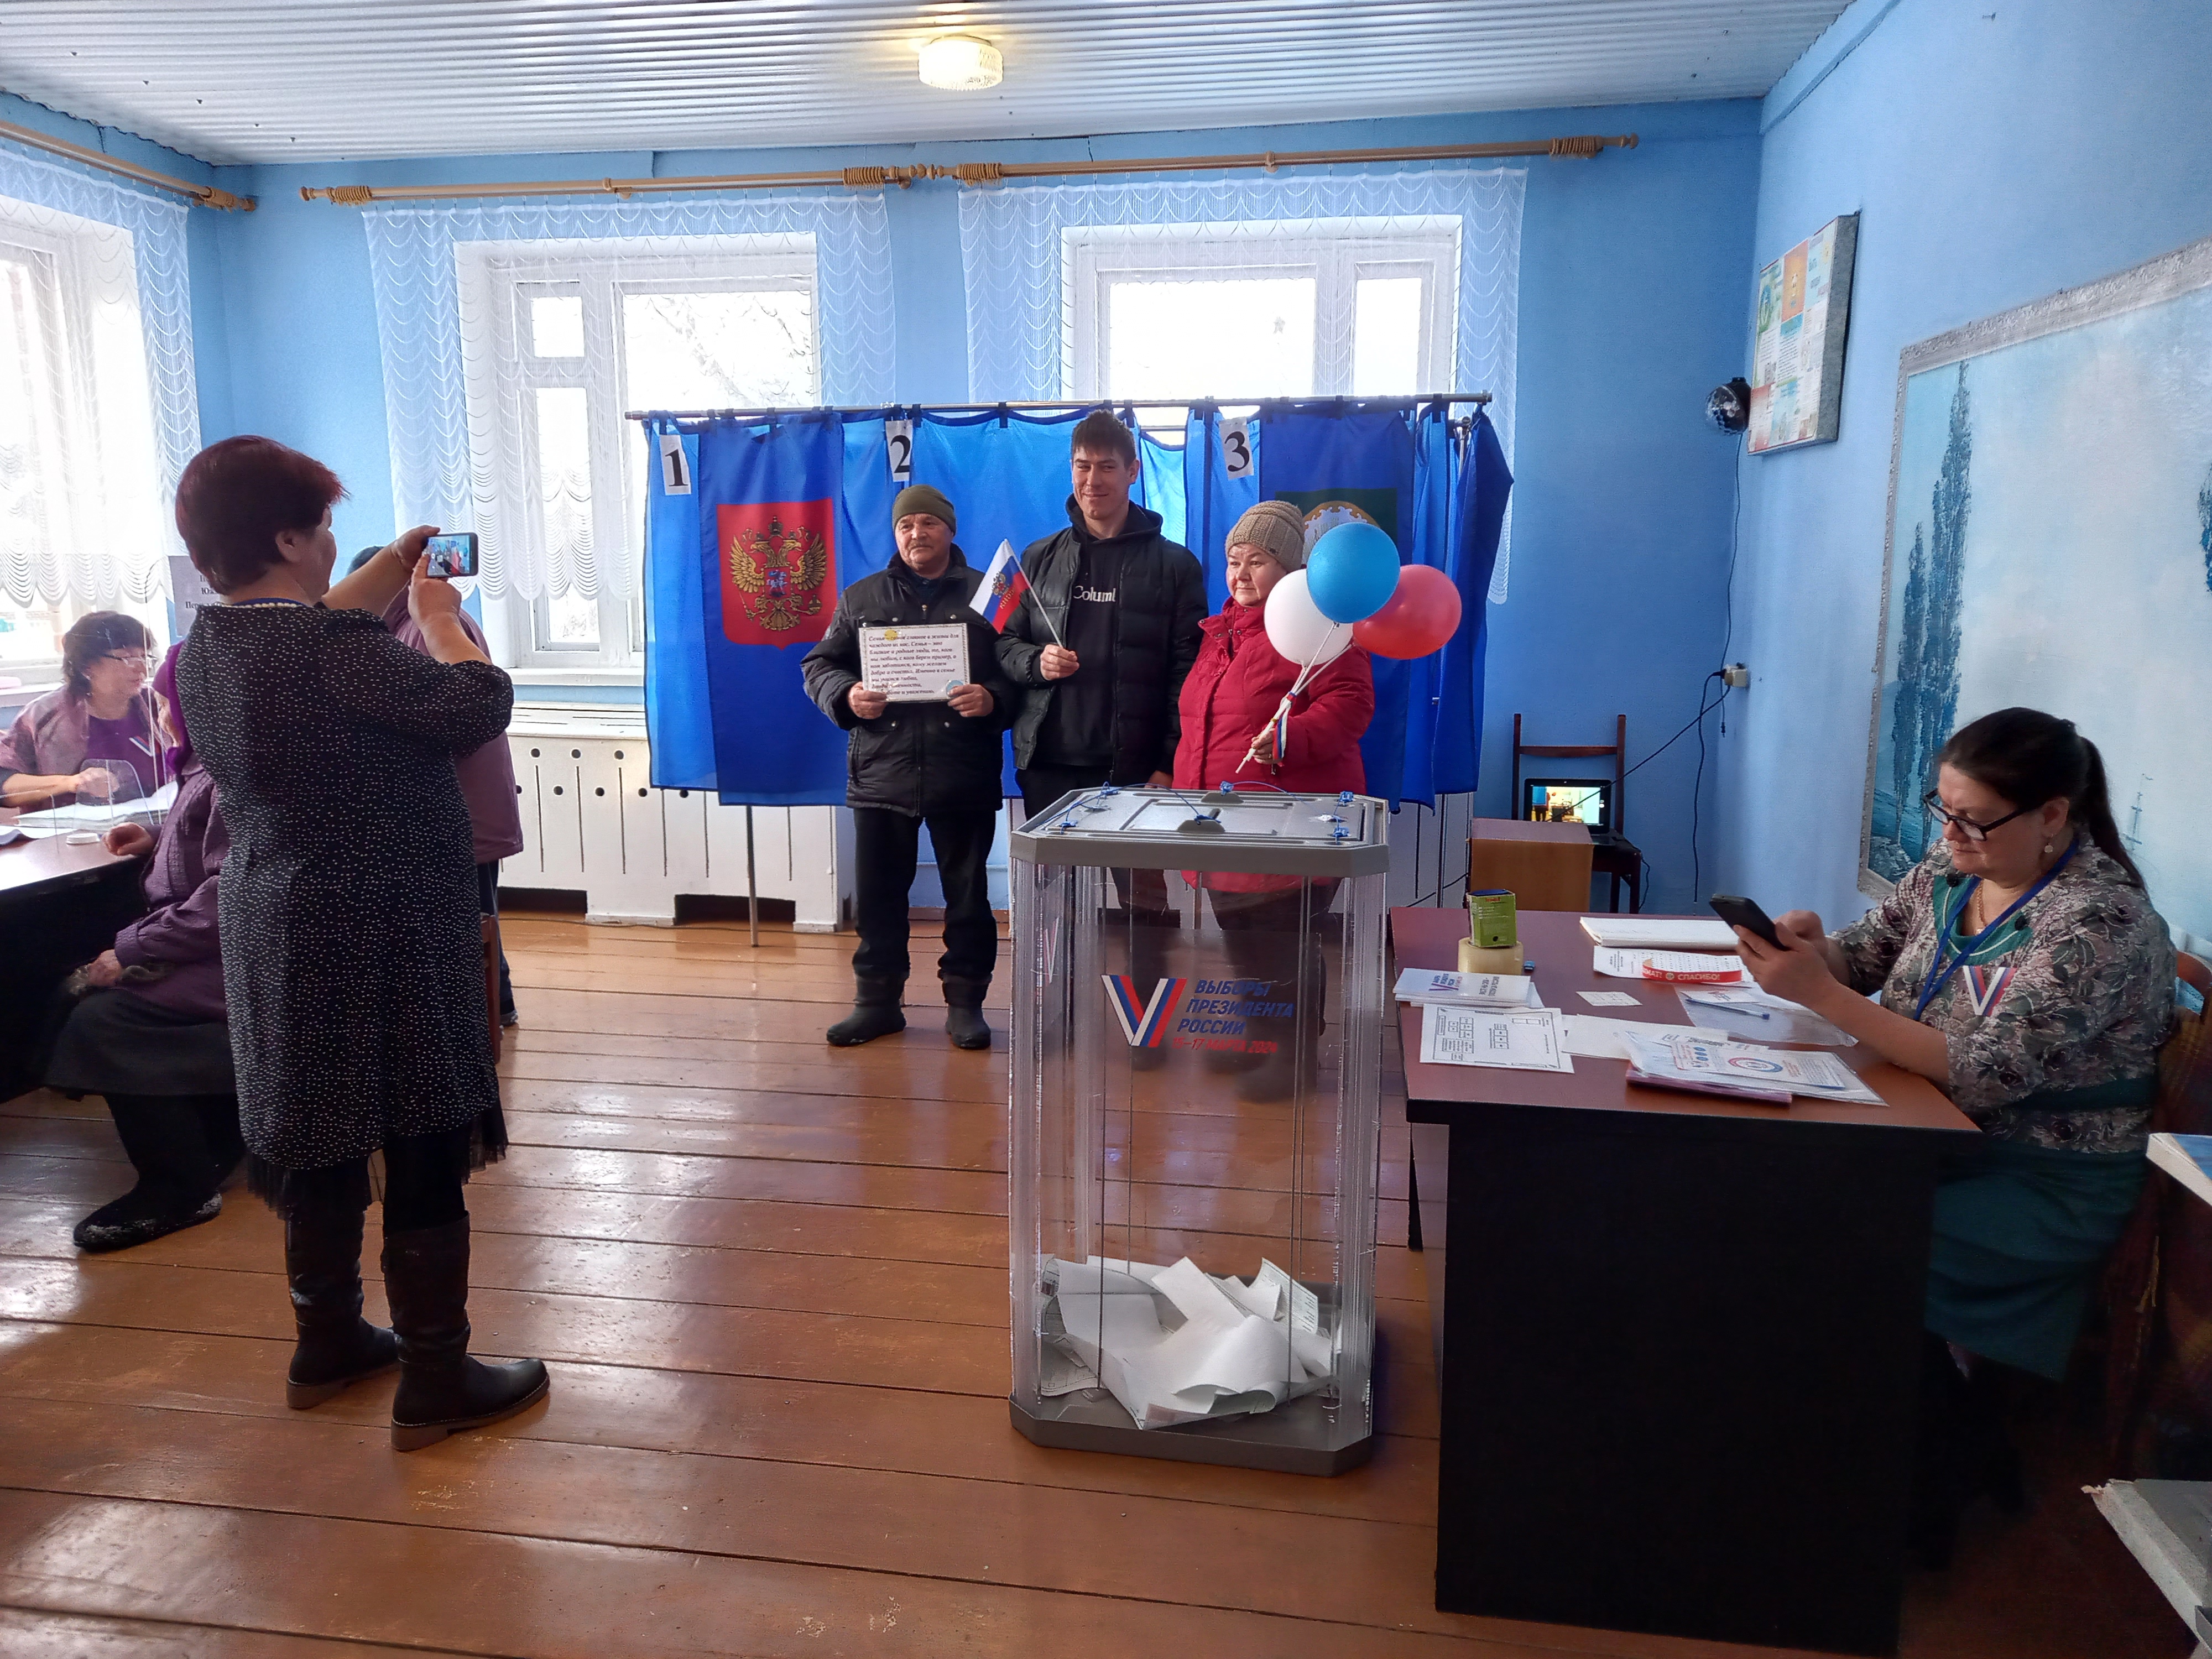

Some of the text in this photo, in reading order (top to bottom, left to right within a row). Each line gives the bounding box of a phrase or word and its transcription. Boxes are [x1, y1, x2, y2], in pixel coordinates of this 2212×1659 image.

[890, 435, 910, 473] 2
[1224, 431, 1249, 472] 3
[665, 449, 688, 486] 1
[1194, 979, 1271, 997] ВЫБОРЫ
[1185, 999, 1295, 1018] ПРЕЗИДЕНТА
[1177, 1019, 1246, 1035] РОССИИ
[1204, 1039, 1246, 1052] МАРТА
[1246, 1041, 1278, 1053] 2024
